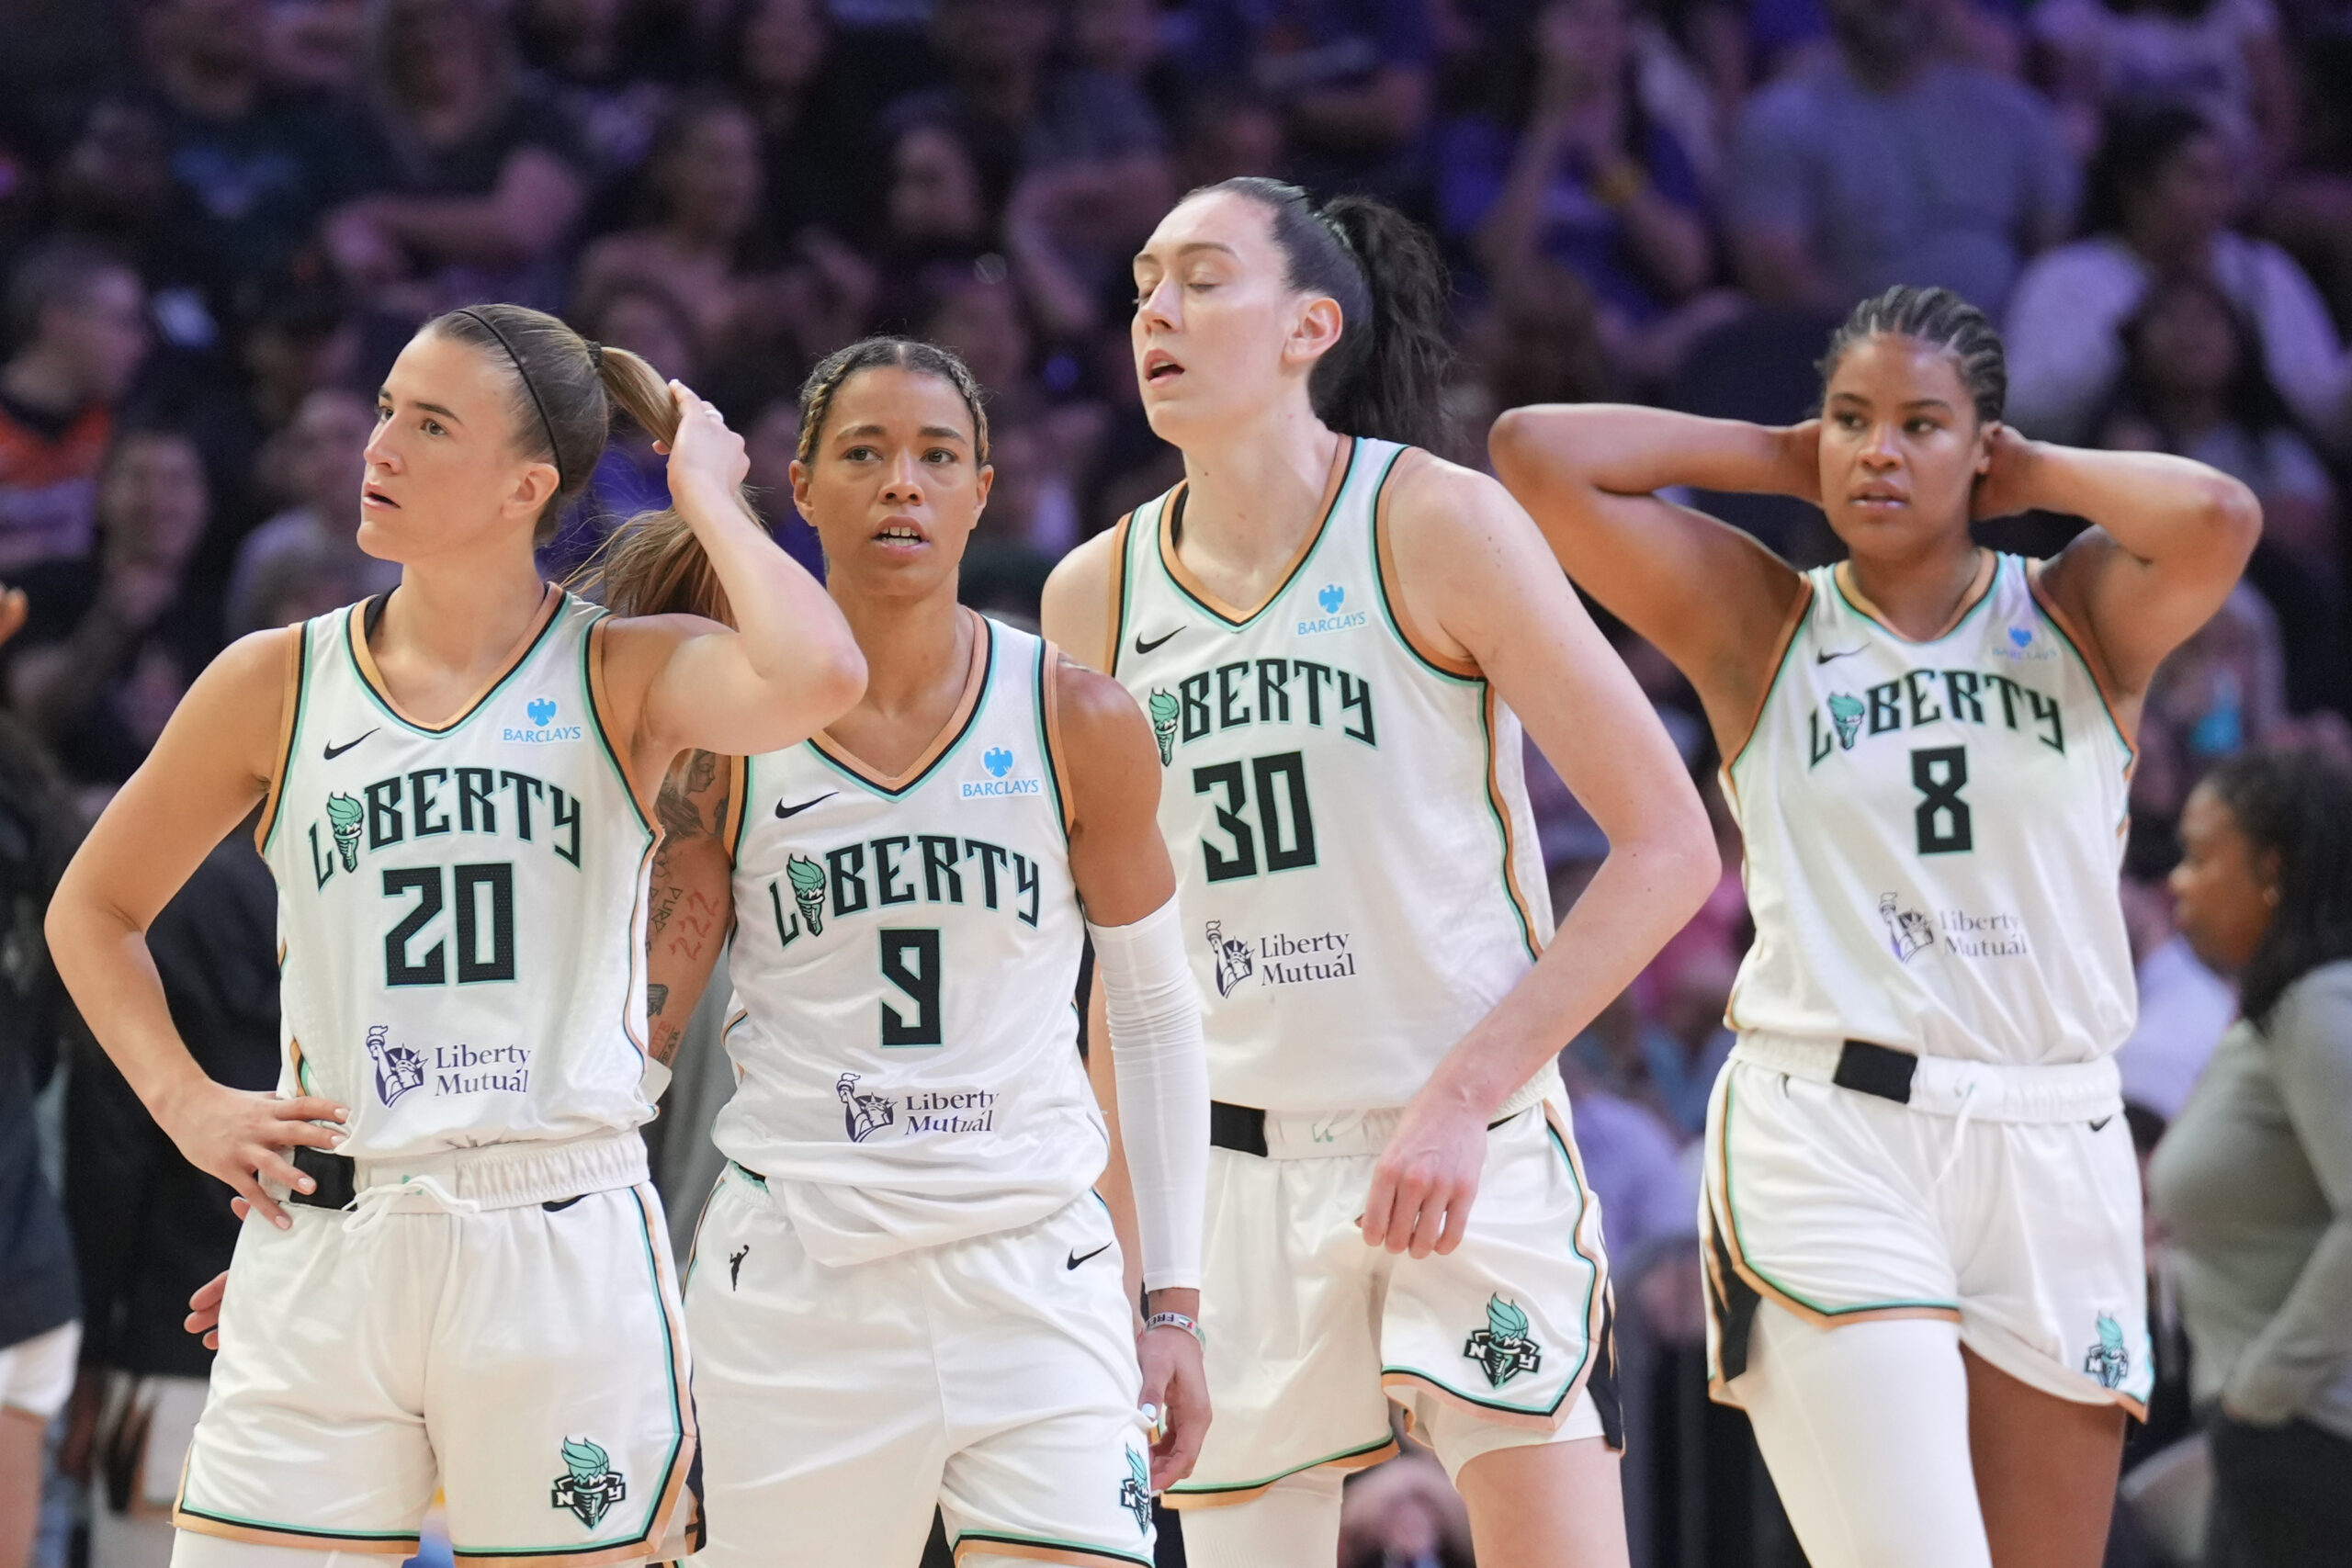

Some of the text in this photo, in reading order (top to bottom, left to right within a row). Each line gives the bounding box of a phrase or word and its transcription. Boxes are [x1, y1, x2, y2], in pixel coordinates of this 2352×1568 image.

[1297, 613, 1366, 636] BARCLAYS
[503, 726, 582, 743] BARCLAYS
[1810, 669, 2065, 771] LIBERTY
[962, 779, 1039, 798] BARCLAYS
[1910, 745, 1973, 856] 8
[309, 767, 581, 894] LIBERTY
[1193, 750, 1319, 886] 30
[769, 834, 1040, 950] LIBERTY
[382, 861, 518, 989] 20
[1940, 910, 2018, 934] Liberty
[1261, 931, 1351, 962] Liberty
[1945, 936, 2027, 956] Mutual
[1261, 956, 1357, 987] Mutual
[878, 927, 944, 1048] 9
[435, 1043, 531, 1077] Liberty
[435, 1072, 529, 1097] Mutual
[906, 1090, 1000, 1116] Liberty
[905, 1112, 994, 1135] Mutual
